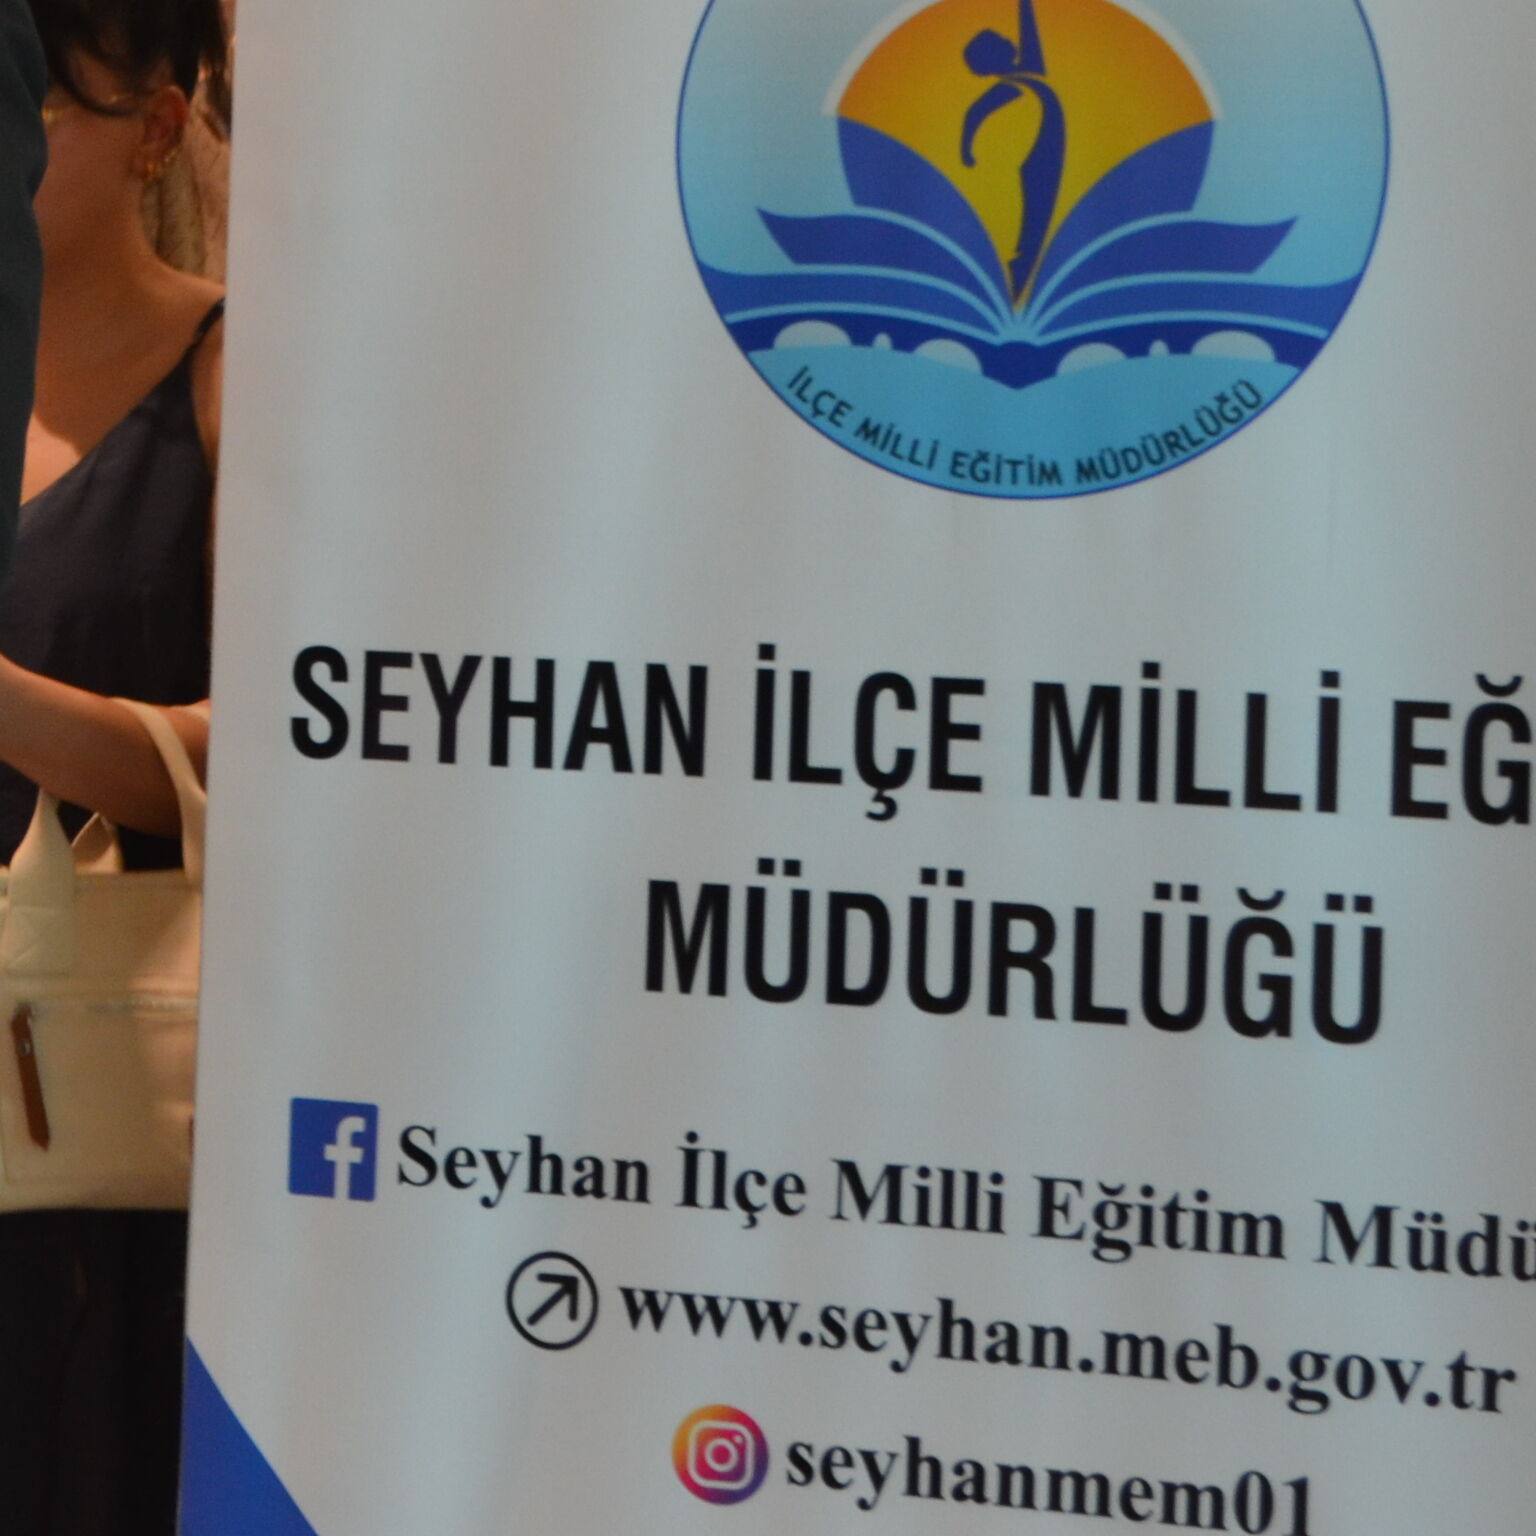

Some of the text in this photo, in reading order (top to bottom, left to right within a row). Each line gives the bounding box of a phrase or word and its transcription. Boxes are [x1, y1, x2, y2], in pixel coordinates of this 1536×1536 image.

[787, 366, 1264, 487] İLÇE MİLLİ EĞİTİM MÜDÜRLÜĞÜ
[289, 643, 709, 780] SEYHAN
[751, 642, 986, 823] İLÇE
[1028, 660, 1341, 815] MİLLİ
[643, 855, 1385, 1046] MÜDÜRLÜĞÜ
[396, 1123, 652, 1209] Seyhan
[674, 1130, 809, 1230] İlçe
[830, 1156, 1008, 1237] Milli
[1030, 1179, 1288, 1264] Eğitim
[618, 1285, 1517, 1416] www.seyhan.meb.gov.tr
[785, 1434, 1313, 1536] seyhanmem01
